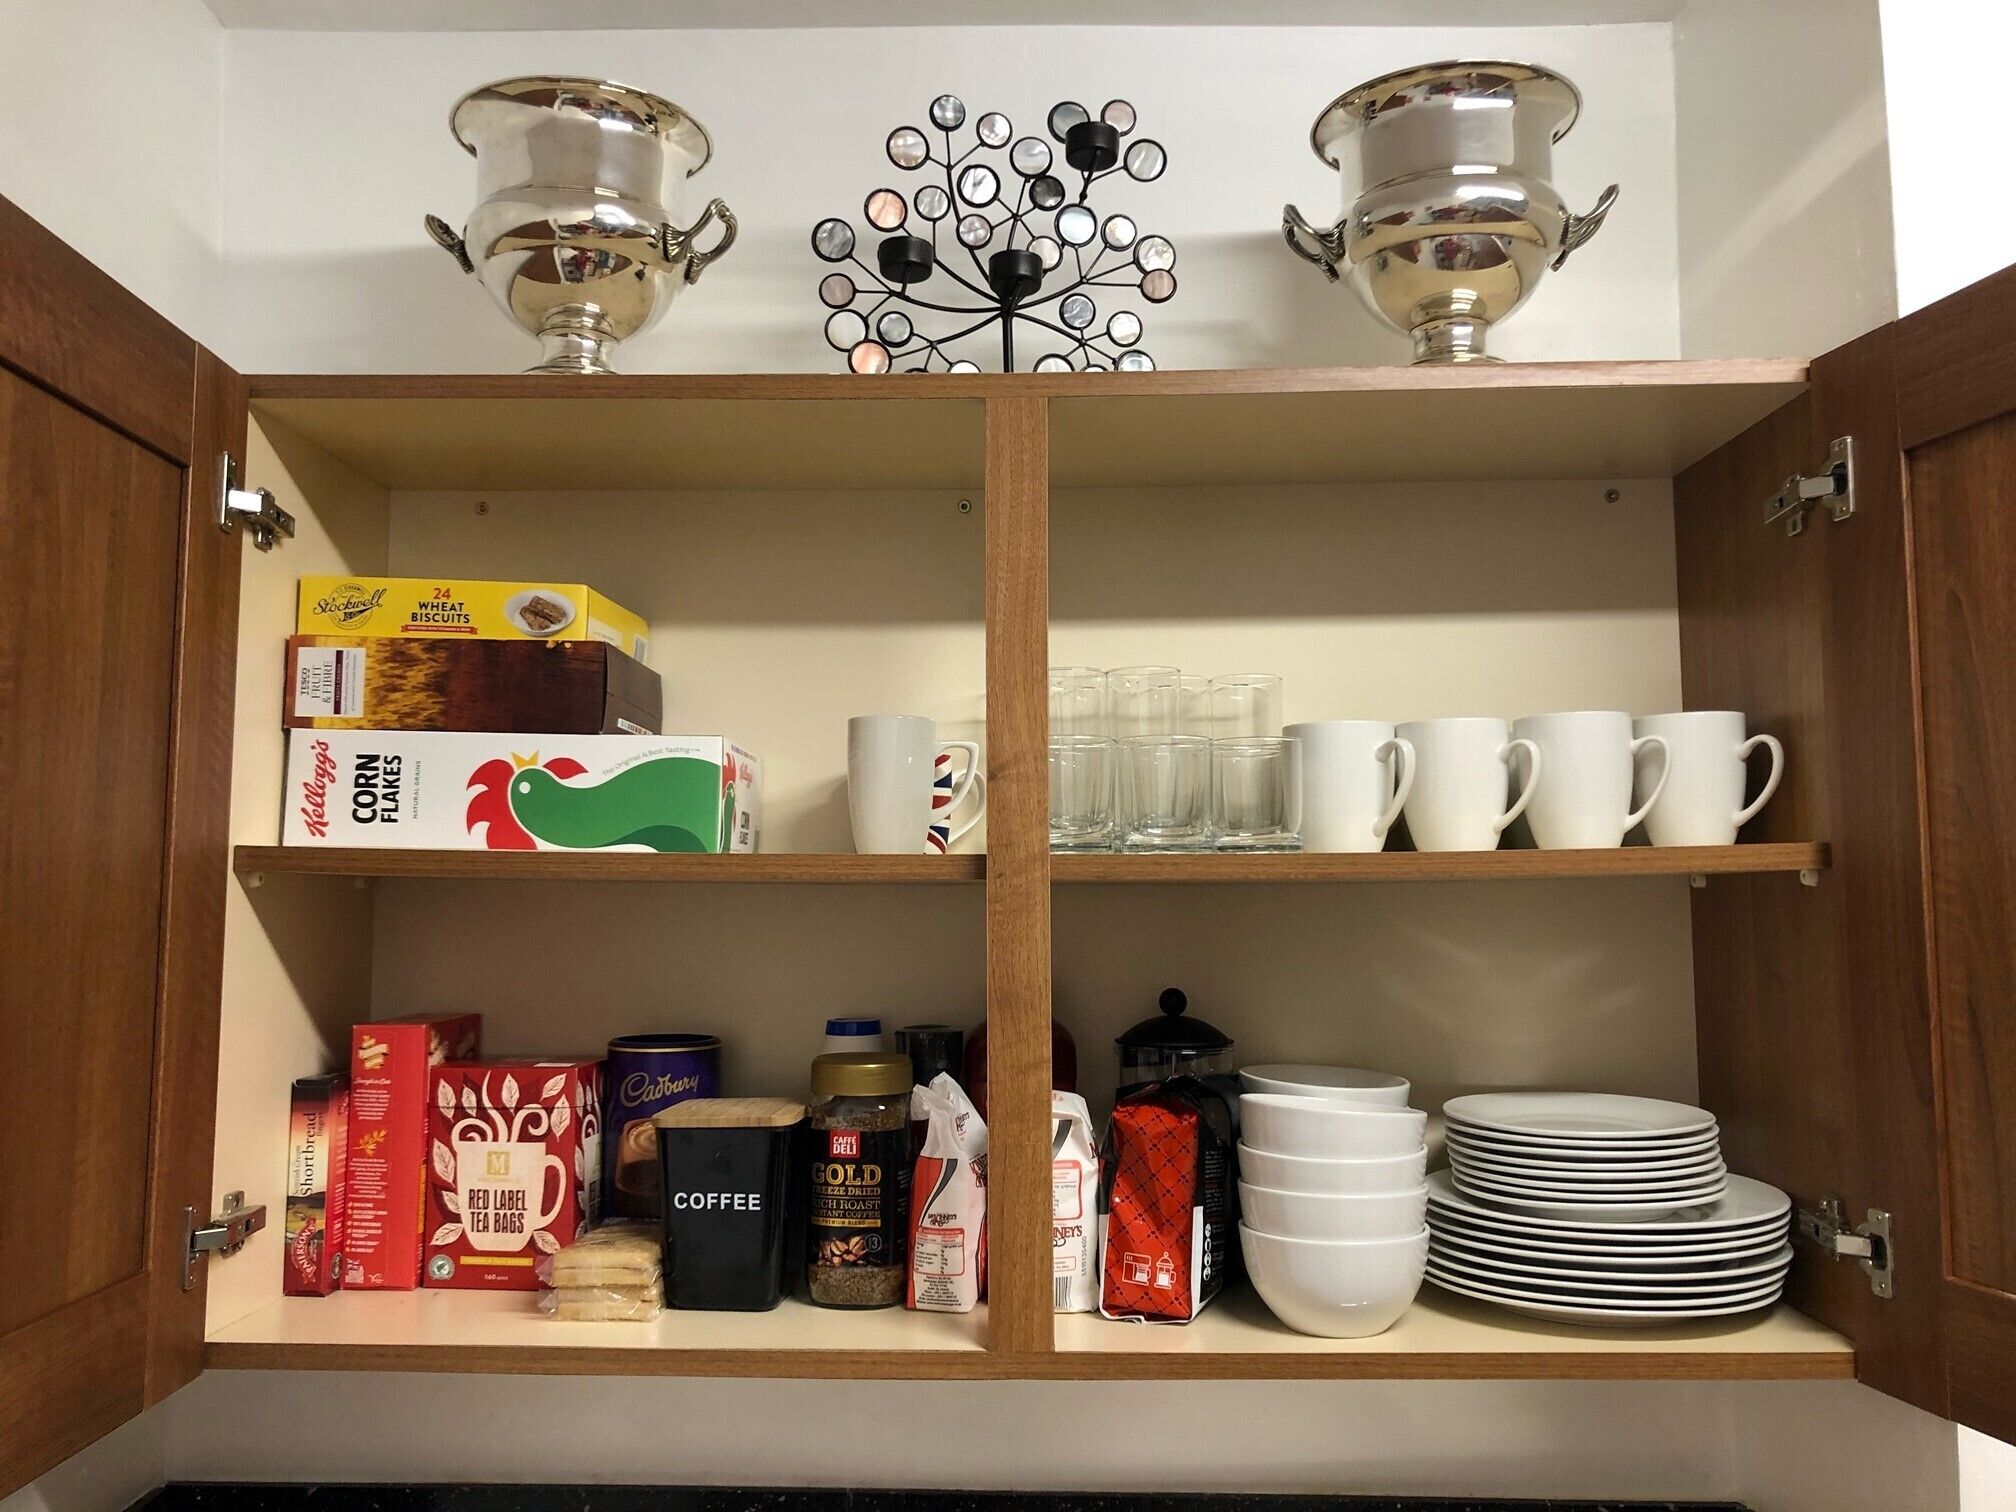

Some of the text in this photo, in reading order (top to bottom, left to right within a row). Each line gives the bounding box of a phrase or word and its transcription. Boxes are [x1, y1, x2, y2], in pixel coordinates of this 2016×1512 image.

[313, 588, 387, 615] Stockwell
[433, 587, 451, 600] 24
[418, 601, 464, 612] WHEAT
[411, 612, 470, 624] BISCUITS
[300, 667, 309, 696] TESCO
[311, 665, 322, 699] FRUIT
[322, 661, 333, 704] & FIBRE
[615, 753, 641, 770] Original
[300, 739, 337, 838] Kellogg's
[351, 754, 381, 824] CORN
[380, 755, 403, 823] FLAKES
[620, 1072, 699, 1107] Cadbury
[299, 1112, 317, 1195] Shortbread
[833, 1144, 857, 1155] DELI
[811, 1162, 881, 1186] GOLD
[468, 1189, 528, 1211] RED LABEL
[673, 1192, 761, 1211] COFFEE
[848, 1186, 881, 1196] DRIED
[840, 1199, 881, 1210] ROAST
[846, 1209, 881, 1219] COFFEE
[470, 1211, 525, 1233] TEA BAGS
